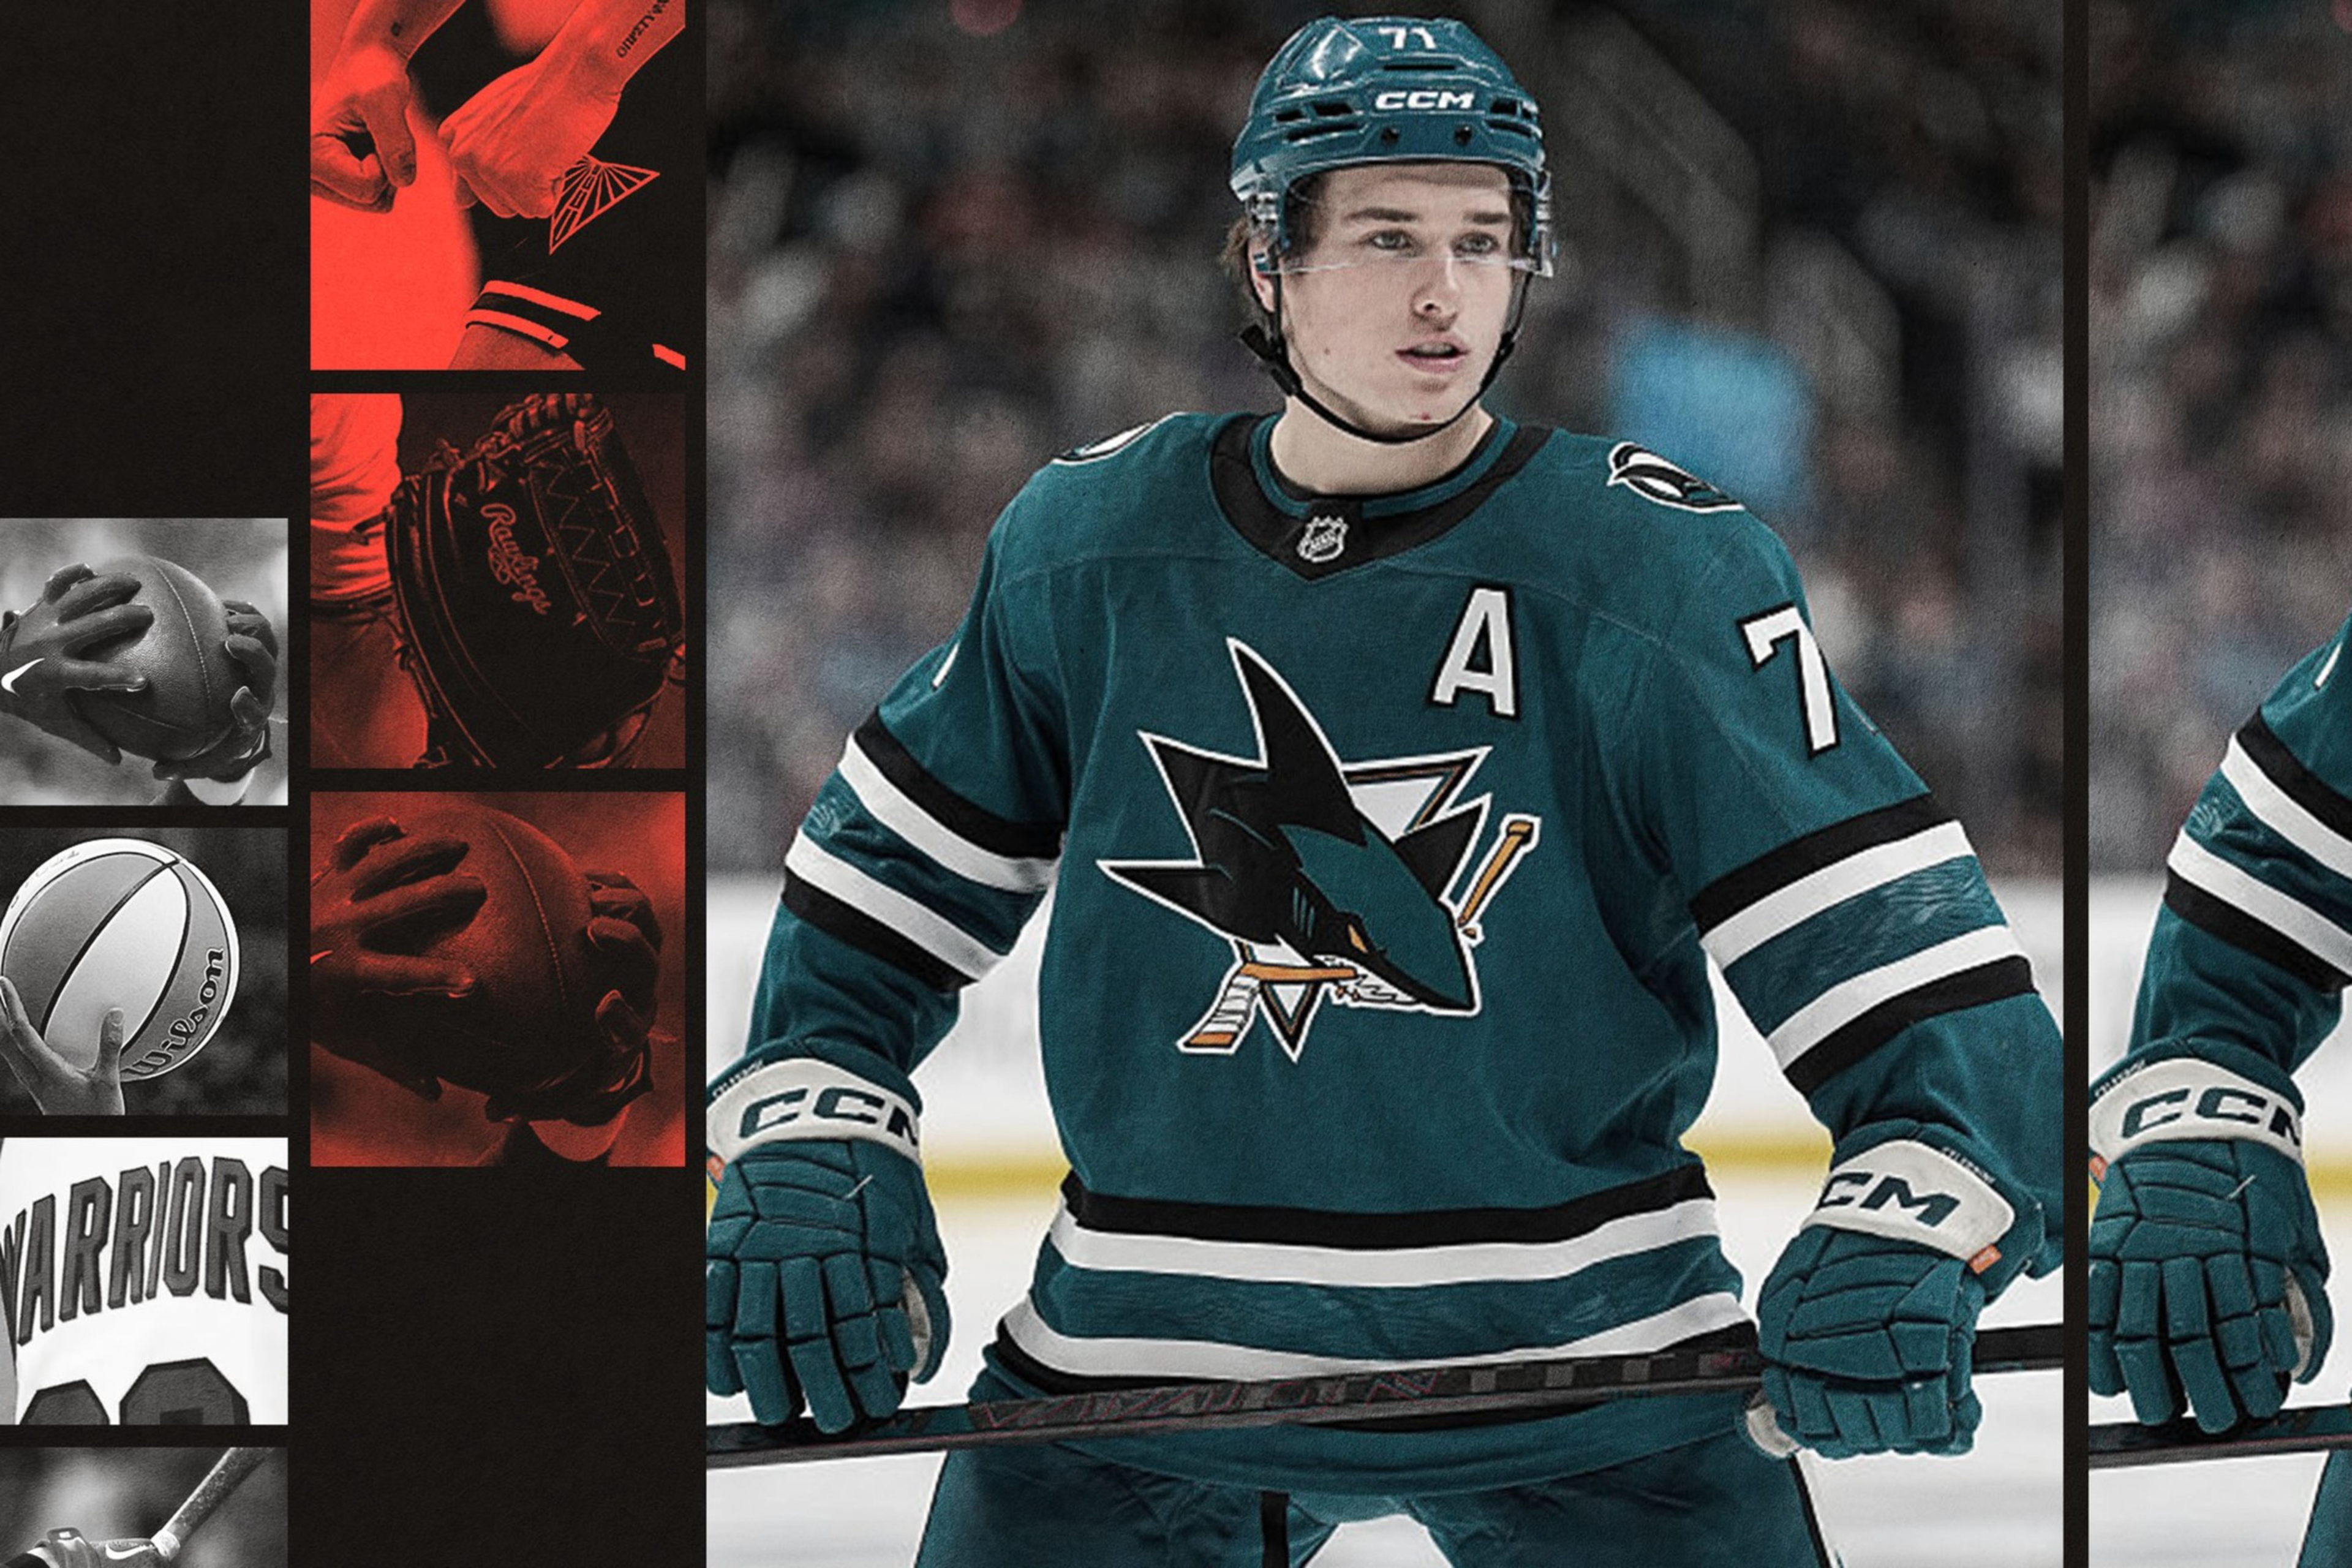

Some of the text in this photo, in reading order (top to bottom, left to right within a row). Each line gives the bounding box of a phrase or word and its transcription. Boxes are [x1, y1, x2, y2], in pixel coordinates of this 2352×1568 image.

[1377, 26, 1437, 50] 71
[1374, 90, 1476, 110] CCM
[480, 502, 551, 615] Rawlings
[1428, 585, 1519, 721] A
[118, 948, 225, 1077] Wilson
[1815, 1171, 1961, 1228] CM
